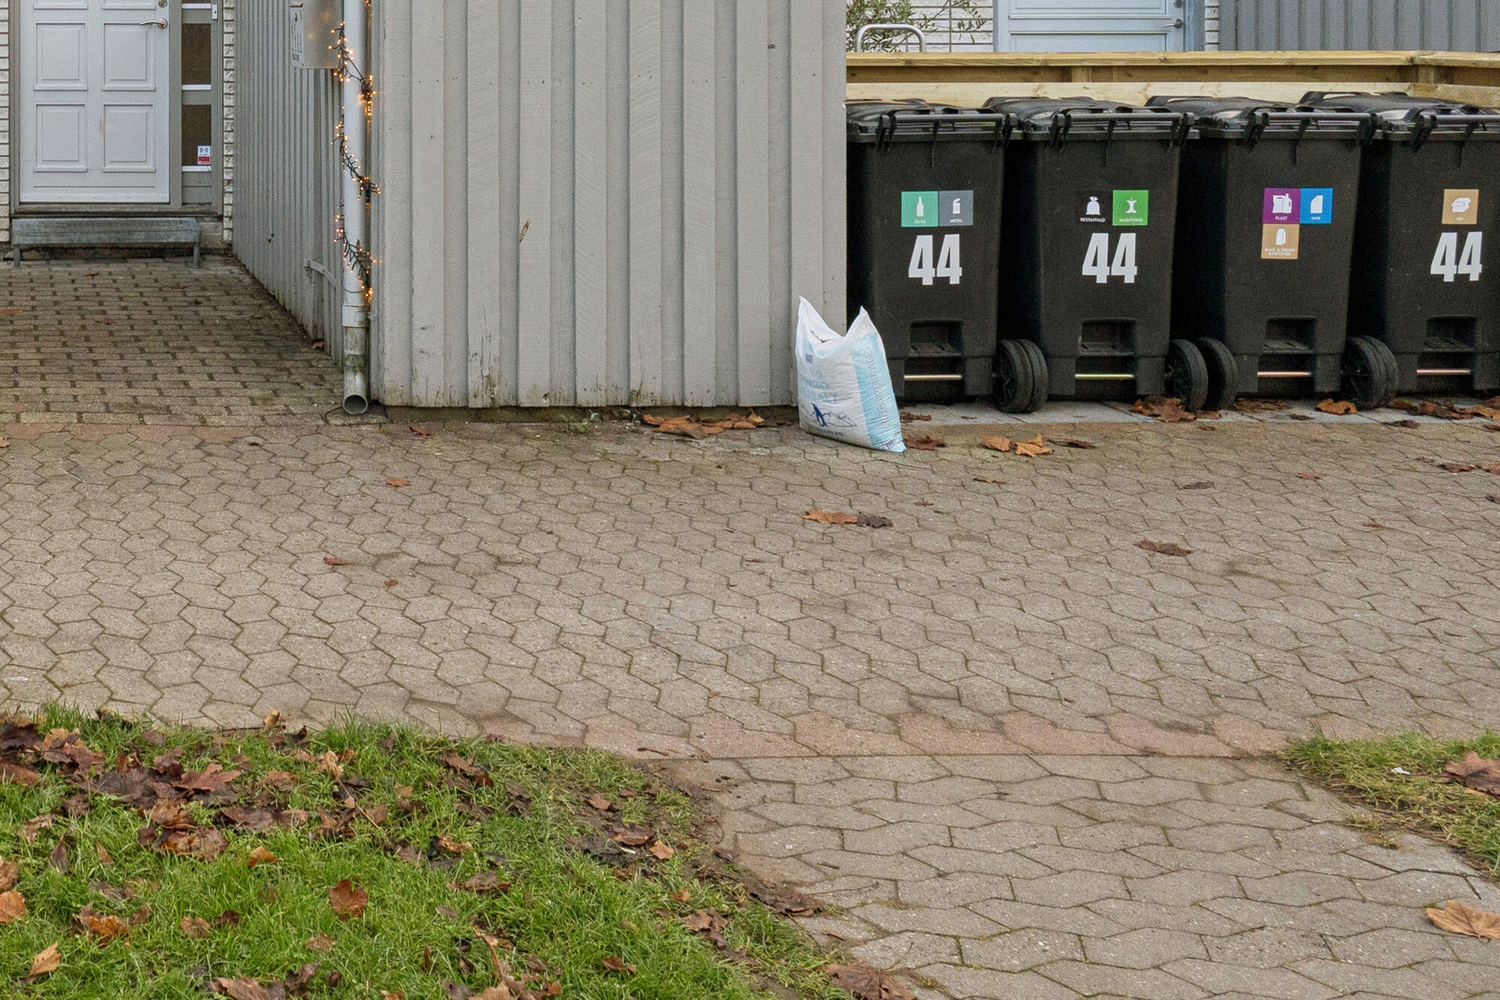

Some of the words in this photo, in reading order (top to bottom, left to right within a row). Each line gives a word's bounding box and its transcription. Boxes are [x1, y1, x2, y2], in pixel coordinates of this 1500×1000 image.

[908, 233, 962, 286] 44
[1082, 232, 1138, 284] 44
[1430, 231, 1483, 282] 44
